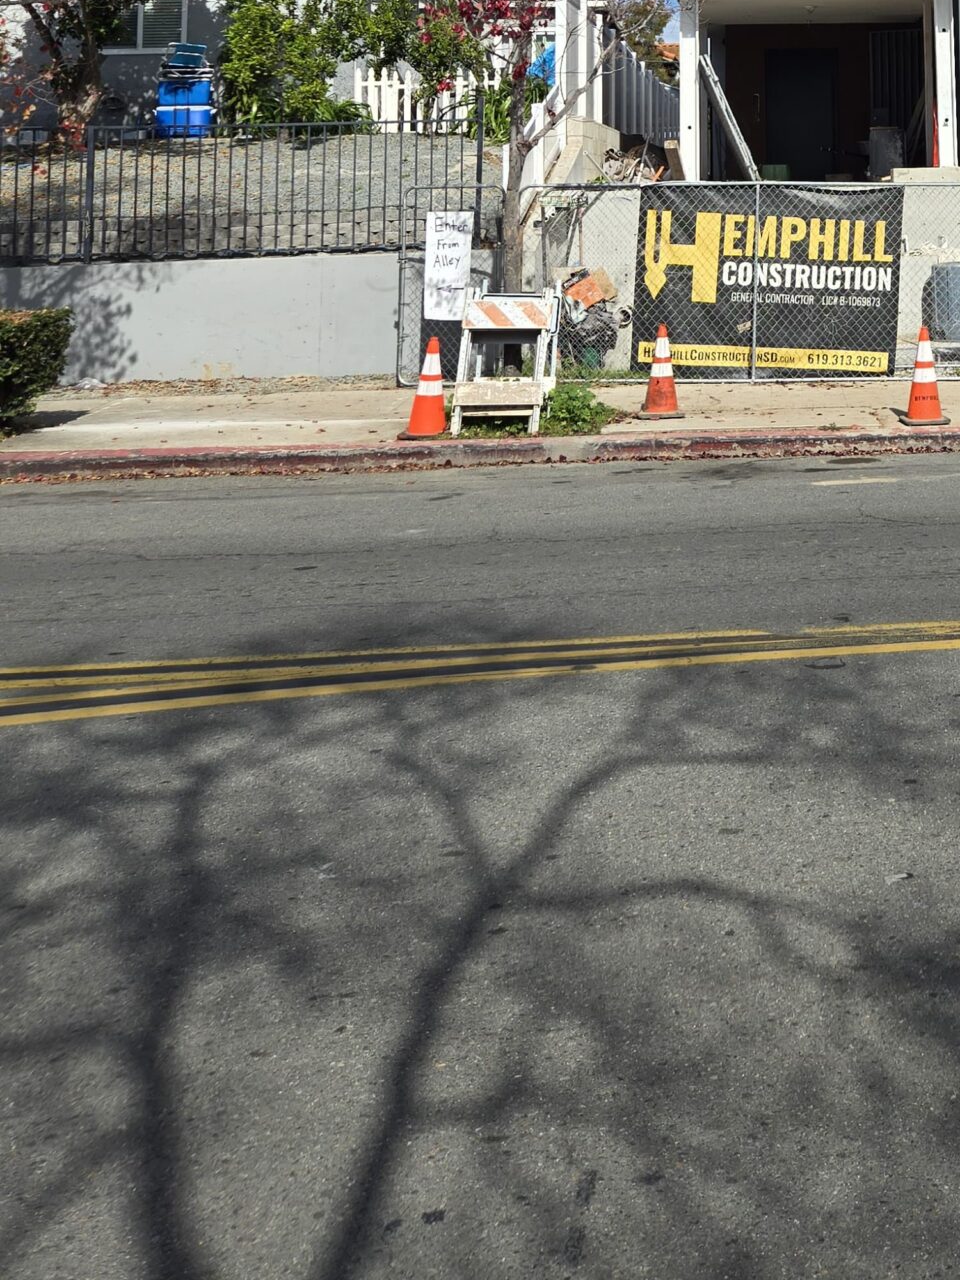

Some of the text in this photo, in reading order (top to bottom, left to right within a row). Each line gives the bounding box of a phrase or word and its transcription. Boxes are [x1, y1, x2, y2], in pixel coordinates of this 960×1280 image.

[435, 217, 468, 232] Enter
[436, 238, 460, 251] From
[434, 254, 460, 269] Alley
[722, 261, 893, 292] CONSTRUCTION
[765, 293, 815, 305] CONTRACTOR
[807, 352, 883, 368] 619.313.3621
